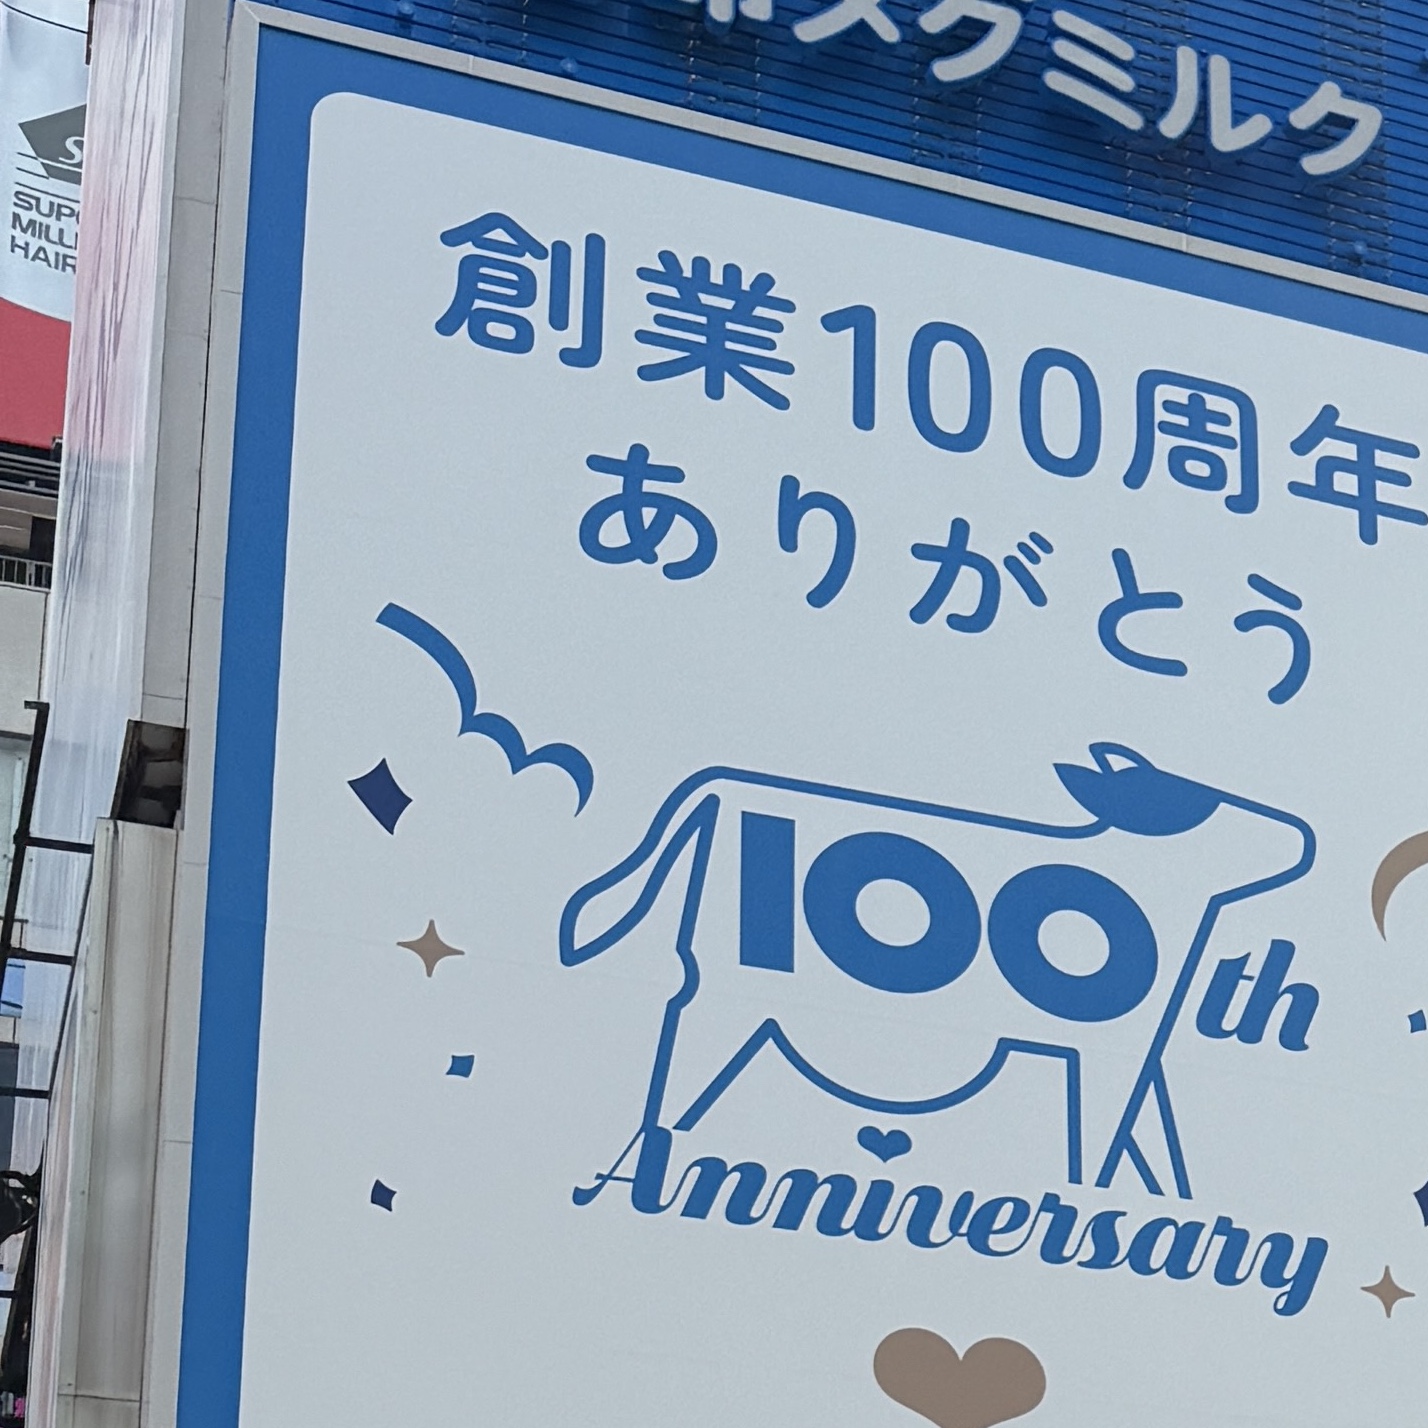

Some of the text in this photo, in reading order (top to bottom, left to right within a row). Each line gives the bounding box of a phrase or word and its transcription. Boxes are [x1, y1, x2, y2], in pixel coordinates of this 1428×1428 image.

[13, 190, 81, 224] SUP
[435, 212, 1428, 545] 創業100周年
[579, 444, 1311, 704] ありがとう
[573, 1124, 1328, 1317] Anniversary
